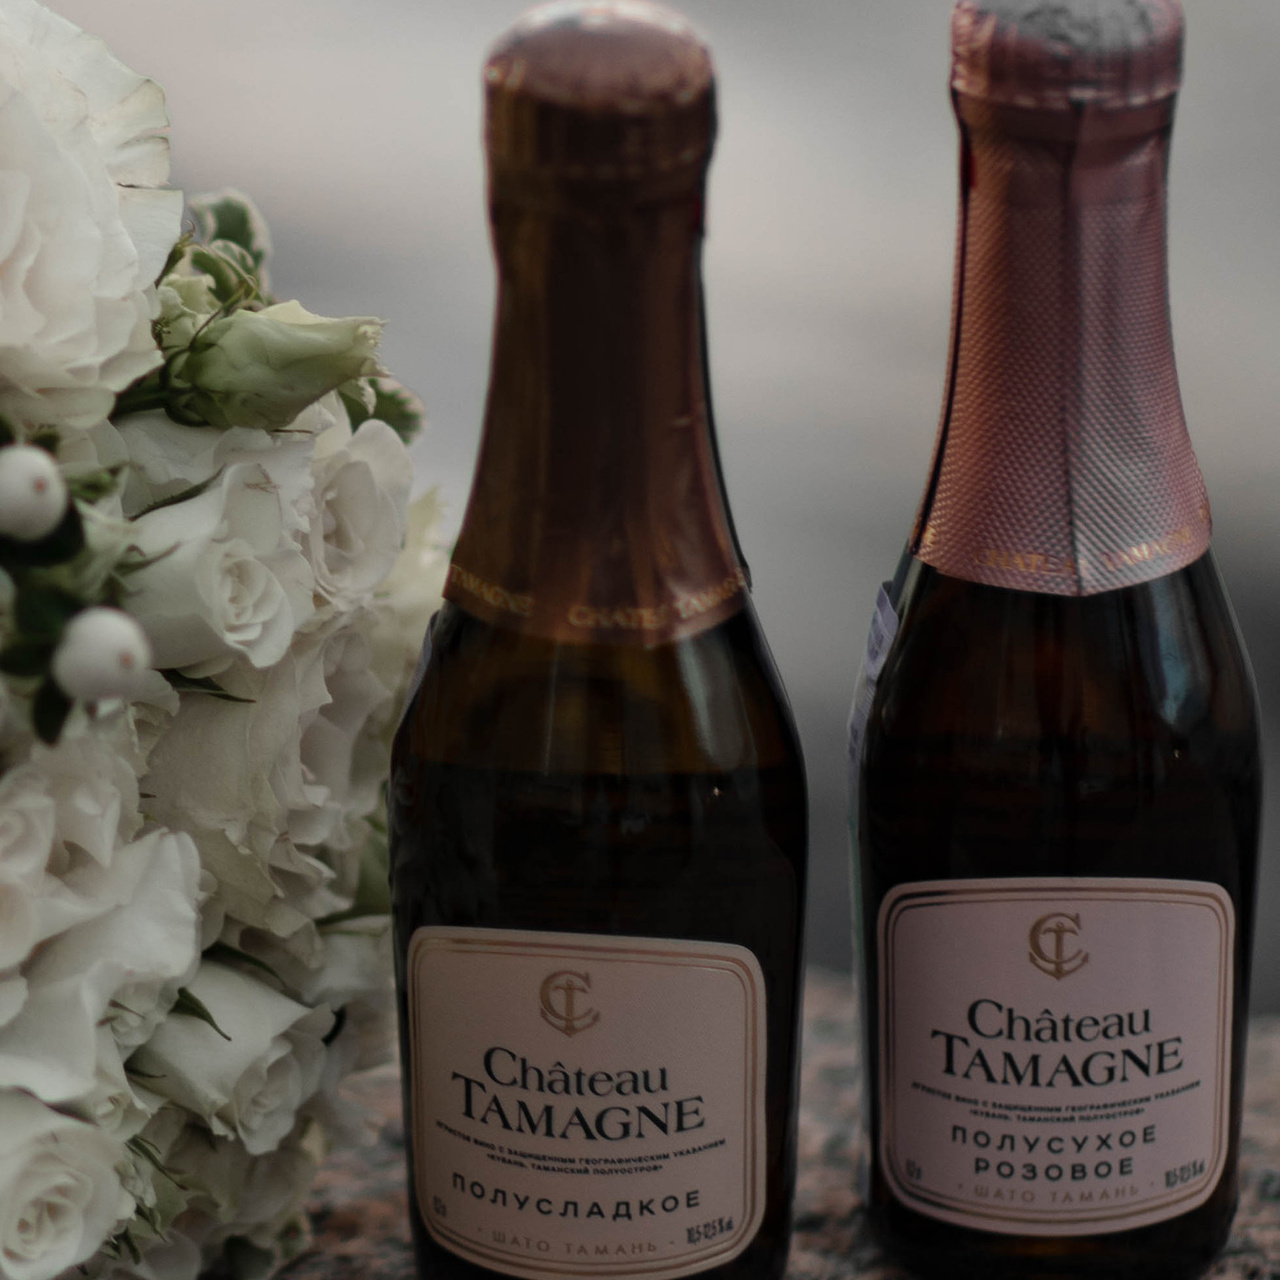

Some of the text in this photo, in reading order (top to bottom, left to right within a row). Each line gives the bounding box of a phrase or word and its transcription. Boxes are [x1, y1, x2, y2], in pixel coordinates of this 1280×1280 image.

[968, 999, 1151, 1043] Château
[483, 1046, 668, 1097] Château
[931, 1029, 1184, 1088] TAMAGNE
[451, 1071, 705, 1142] TAMAGNE
[951, 1124, 1156, 1154] ПОЛУСУХОЕ
[974, 1157, 1133, 1182] РОЗОВОЕ
[452, 1172, 700, 1222] ПОЛУСЛАДКОЕ
[974, 1184, 1139, 1204] ШАТО ТАМАНЬ
[492, 1229, 657, 1256] ШАТО ТАМАНЬ
